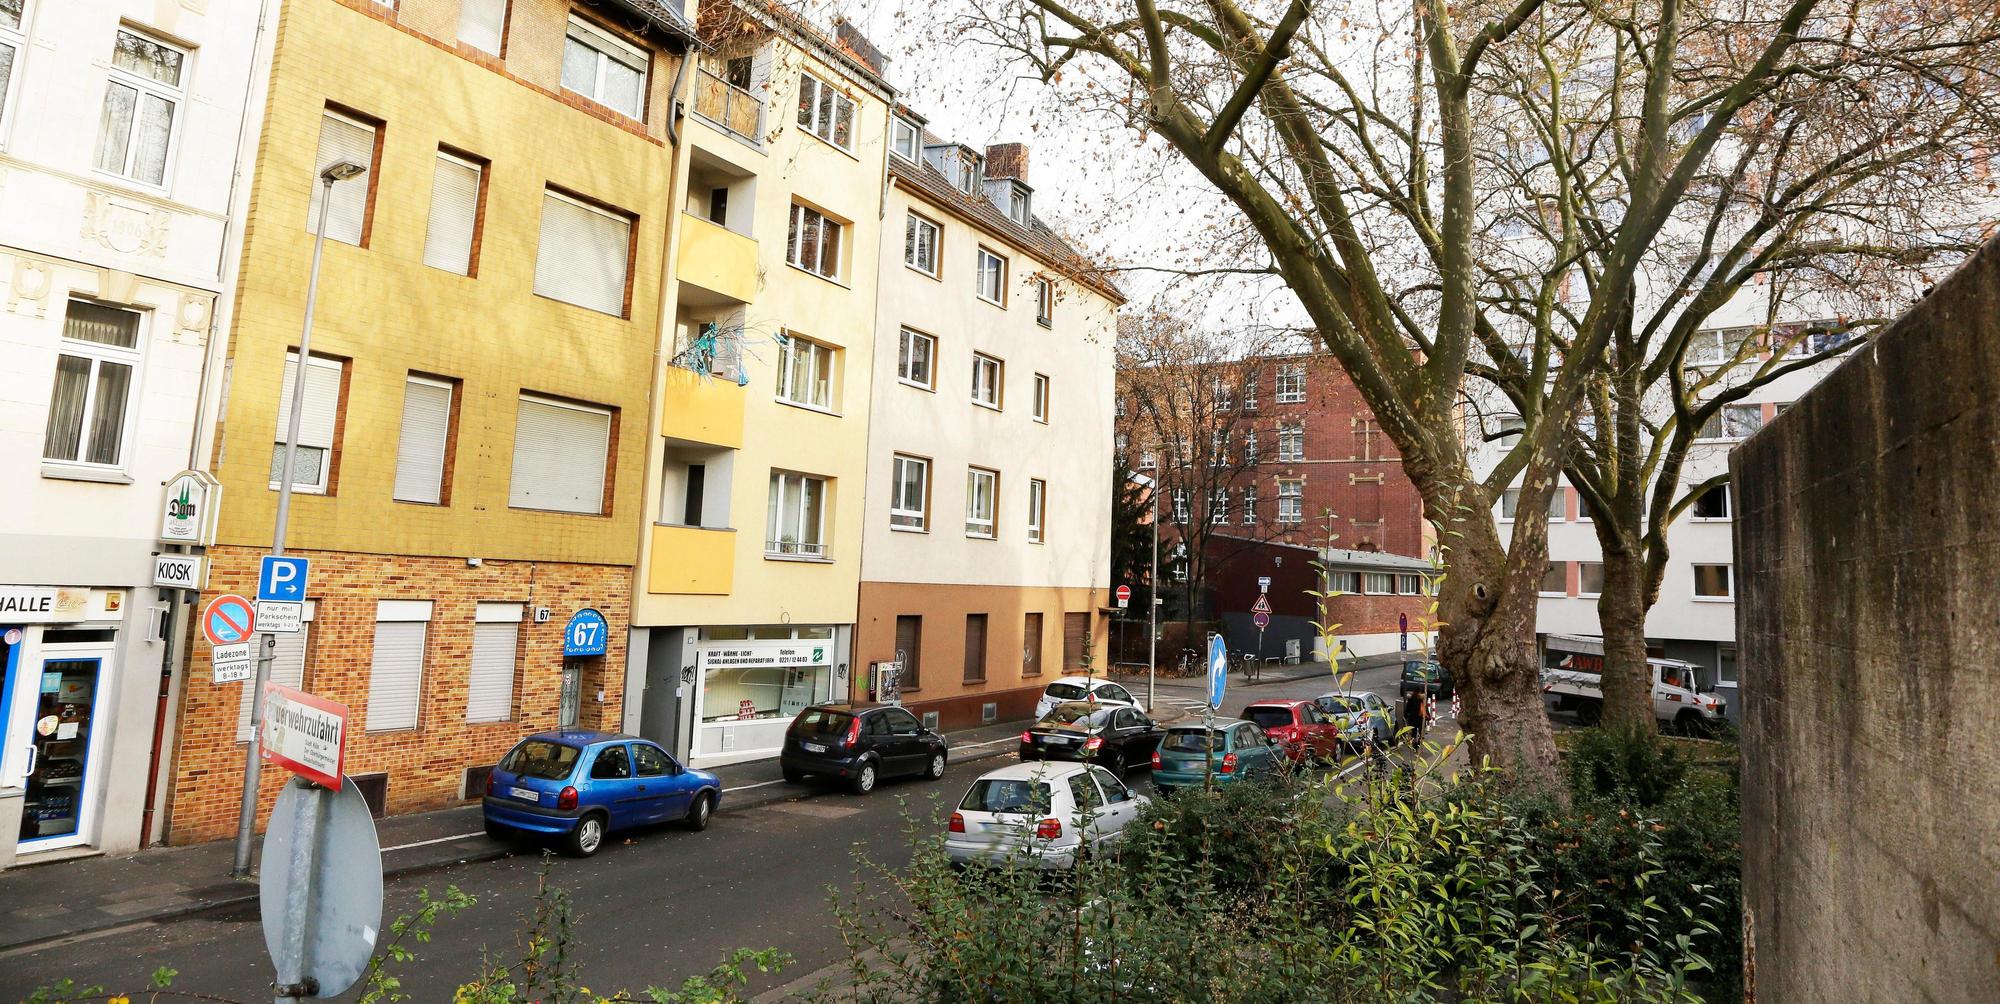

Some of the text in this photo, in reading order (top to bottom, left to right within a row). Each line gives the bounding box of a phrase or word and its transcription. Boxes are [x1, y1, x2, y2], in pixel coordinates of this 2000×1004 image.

[168, 498, 196, 517] Dom
[157, 562, 191, 581] KIOSK
[269, 561, 297, 594] P
[259, 612, 298, 620] Parkschein
[540, 609, 549, 620] 67
[573, 622, 599, 646] 67
[216, 649, 247, 660] Ladezone
[1573, 655, 1604, 672] AWB
[217, 663, 249, 673] werktags
[268, 703, 339, 745] uerwehrzufahrt
